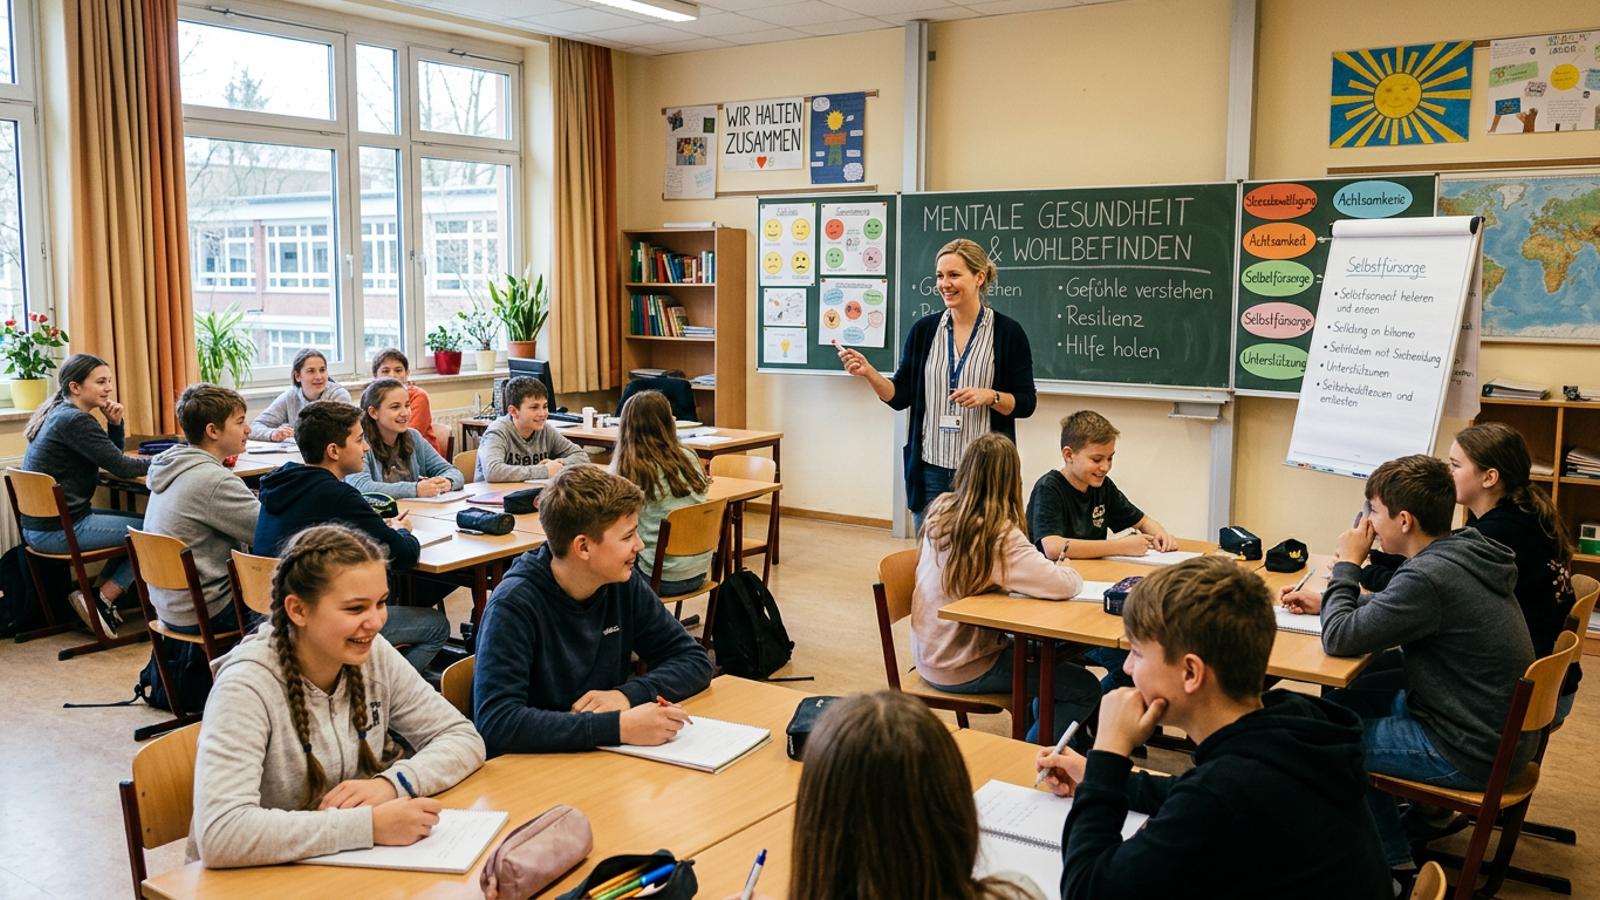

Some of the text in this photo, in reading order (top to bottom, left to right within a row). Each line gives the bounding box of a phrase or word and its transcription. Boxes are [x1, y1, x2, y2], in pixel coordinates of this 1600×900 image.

[726, 105, 750, 127] WIR
[756, 102, 801, 125] HALTEN
[725, 128, 801, 154] ZUSAMMEN
[923, 197, 1195, 232] MENTALE GESUNDHEIT
[988, 234, 1193, 262] & WOHLBEFINDEN
[1346, 256, 1427, 280] Selbstfürsorge
[1066, 277, 1213, 302] Gefühle verstehen
[1066, 305, 1145, 328] Resilienz
[1066, 335, 1160, 361] Hilfe holen
